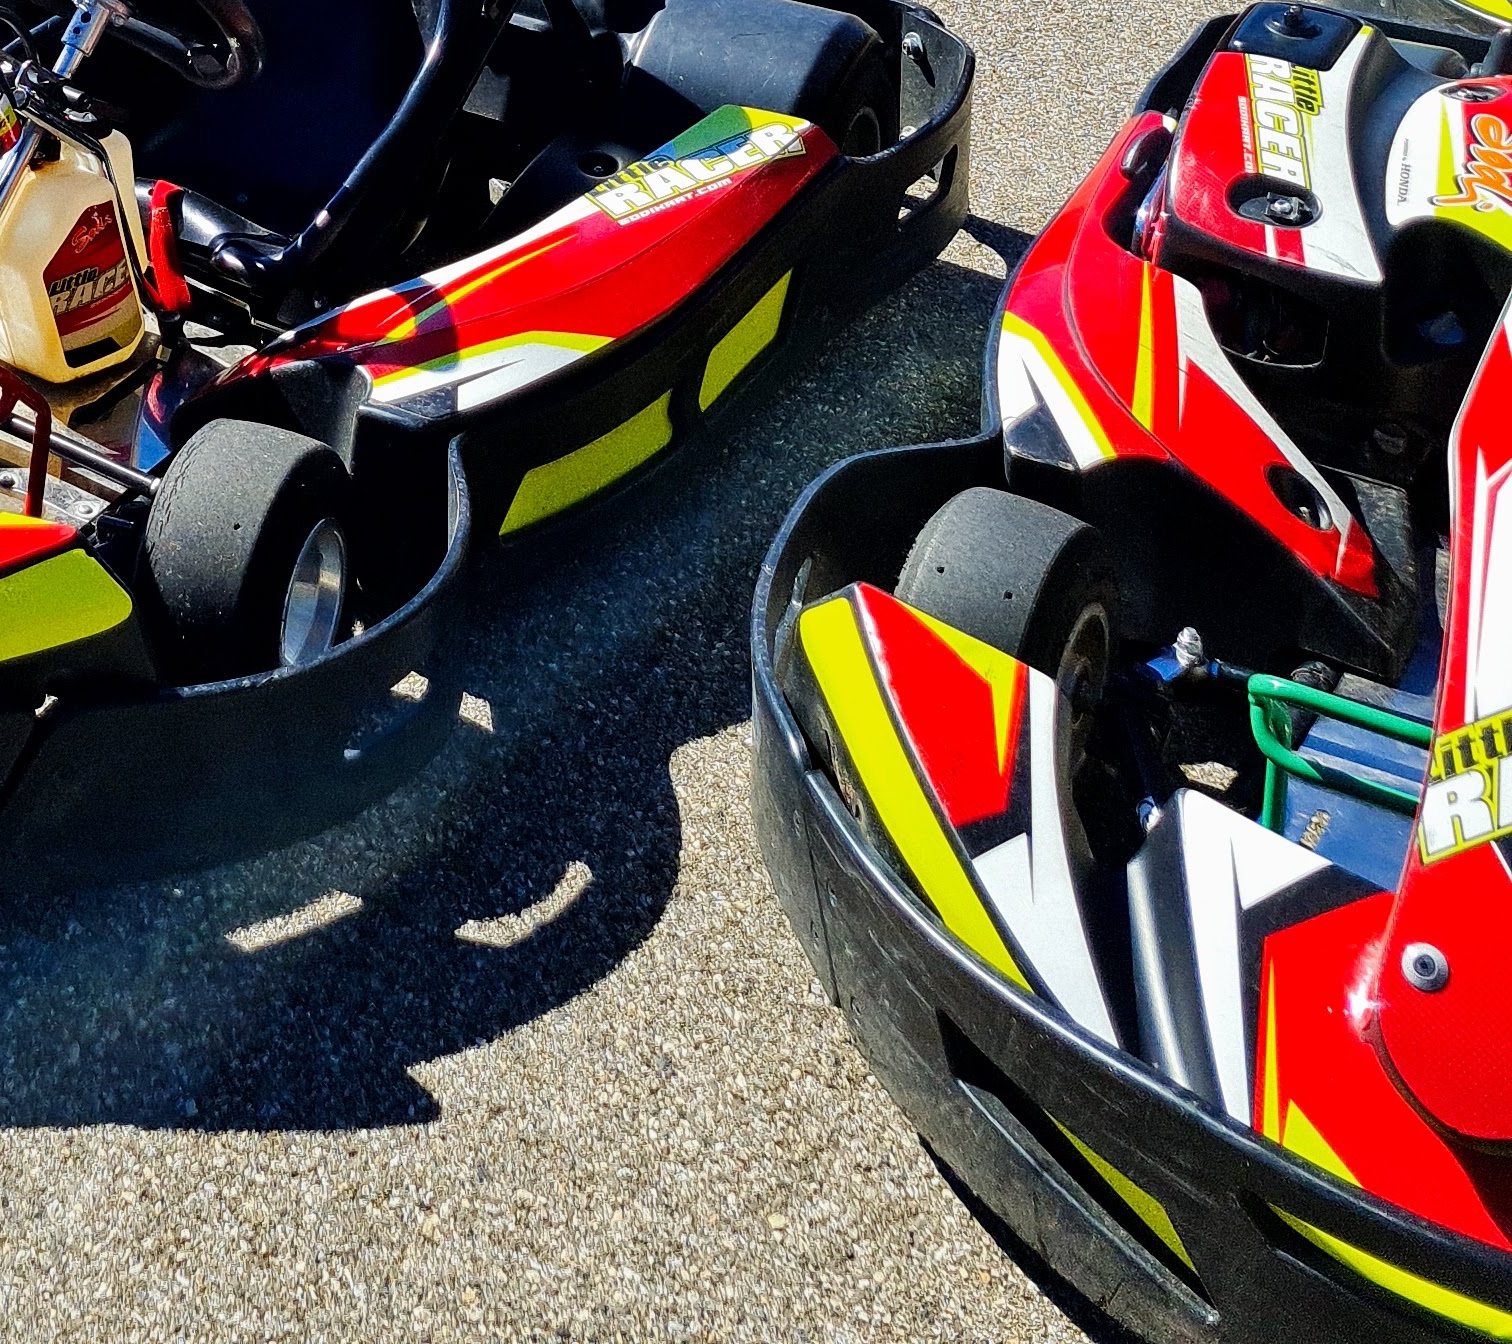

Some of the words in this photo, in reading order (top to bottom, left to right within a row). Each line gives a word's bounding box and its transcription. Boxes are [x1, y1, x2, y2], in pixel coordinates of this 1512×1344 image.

[1248, 53, 1307, 189] RACER
[592, 122, 806, 219] RACER
[1397, 162, 1411, 206] HONDA
